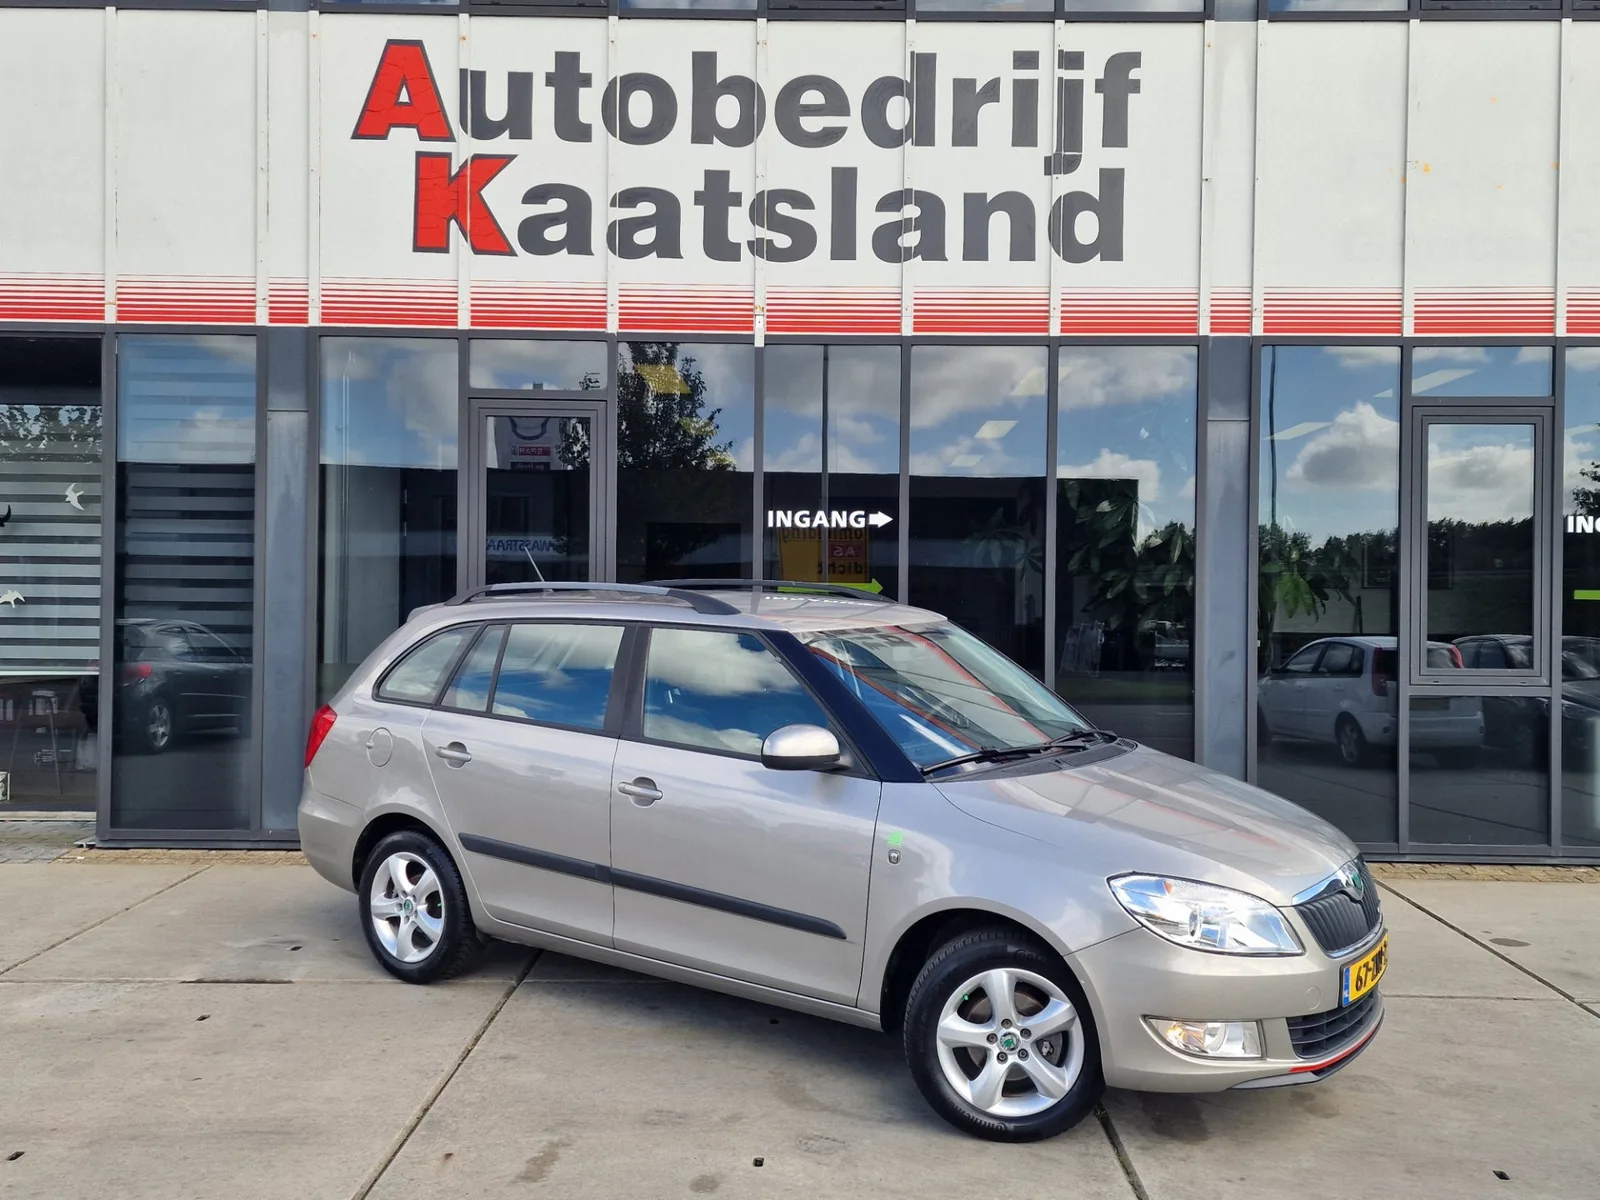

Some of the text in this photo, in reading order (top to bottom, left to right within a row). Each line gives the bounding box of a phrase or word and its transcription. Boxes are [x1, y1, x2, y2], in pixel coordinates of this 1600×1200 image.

[351, 39, 1142, 174] Autobedrijf
[412, 150, 1124, 263] Kaatsland
[767, 510, 866, 528] INGANG
